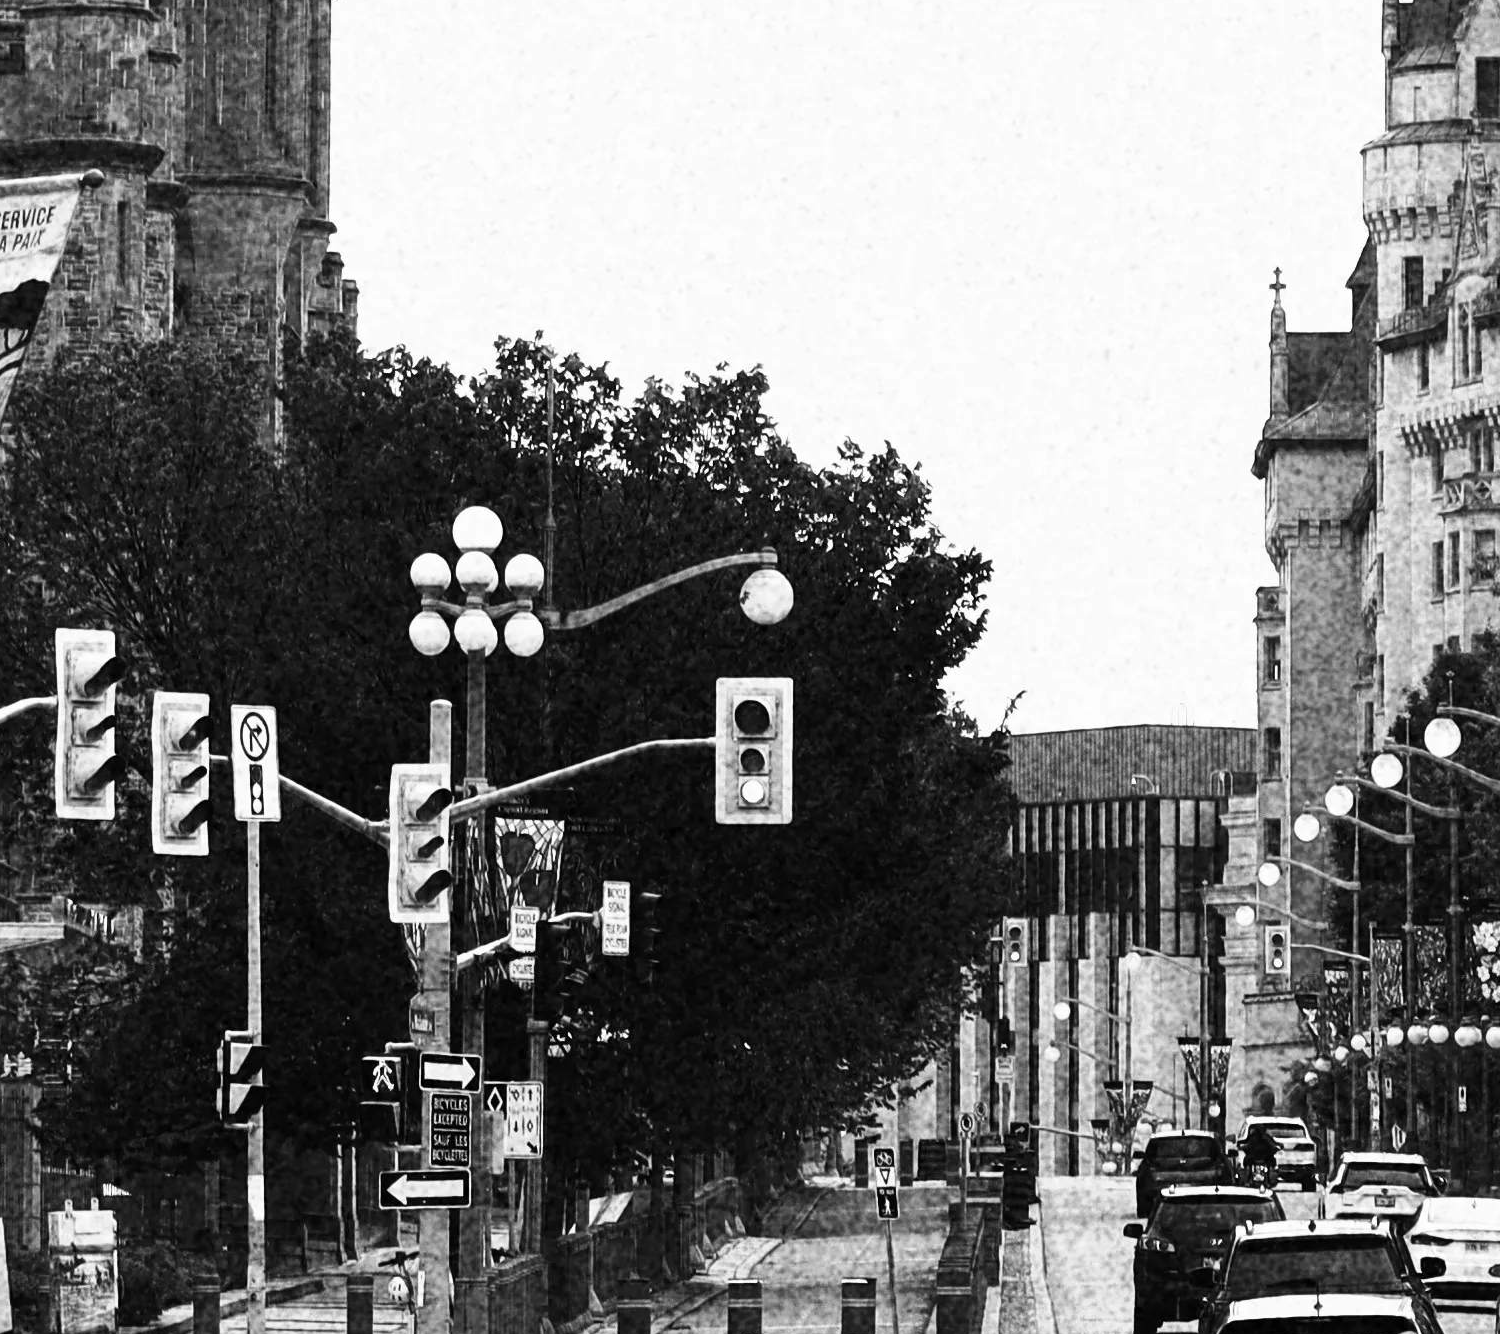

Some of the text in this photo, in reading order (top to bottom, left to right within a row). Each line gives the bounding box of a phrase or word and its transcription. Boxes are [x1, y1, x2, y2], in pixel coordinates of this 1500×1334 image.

[12, 228, 46, 252] PAIX
[433, 1097, 468, 1112] BICYCLES
[433, 1114, 468, 1127] EXCEPTED
[433, 1135, 468, 1146] SAUF LES
[432, 1149, 468, 1163] BICYCLETTES
